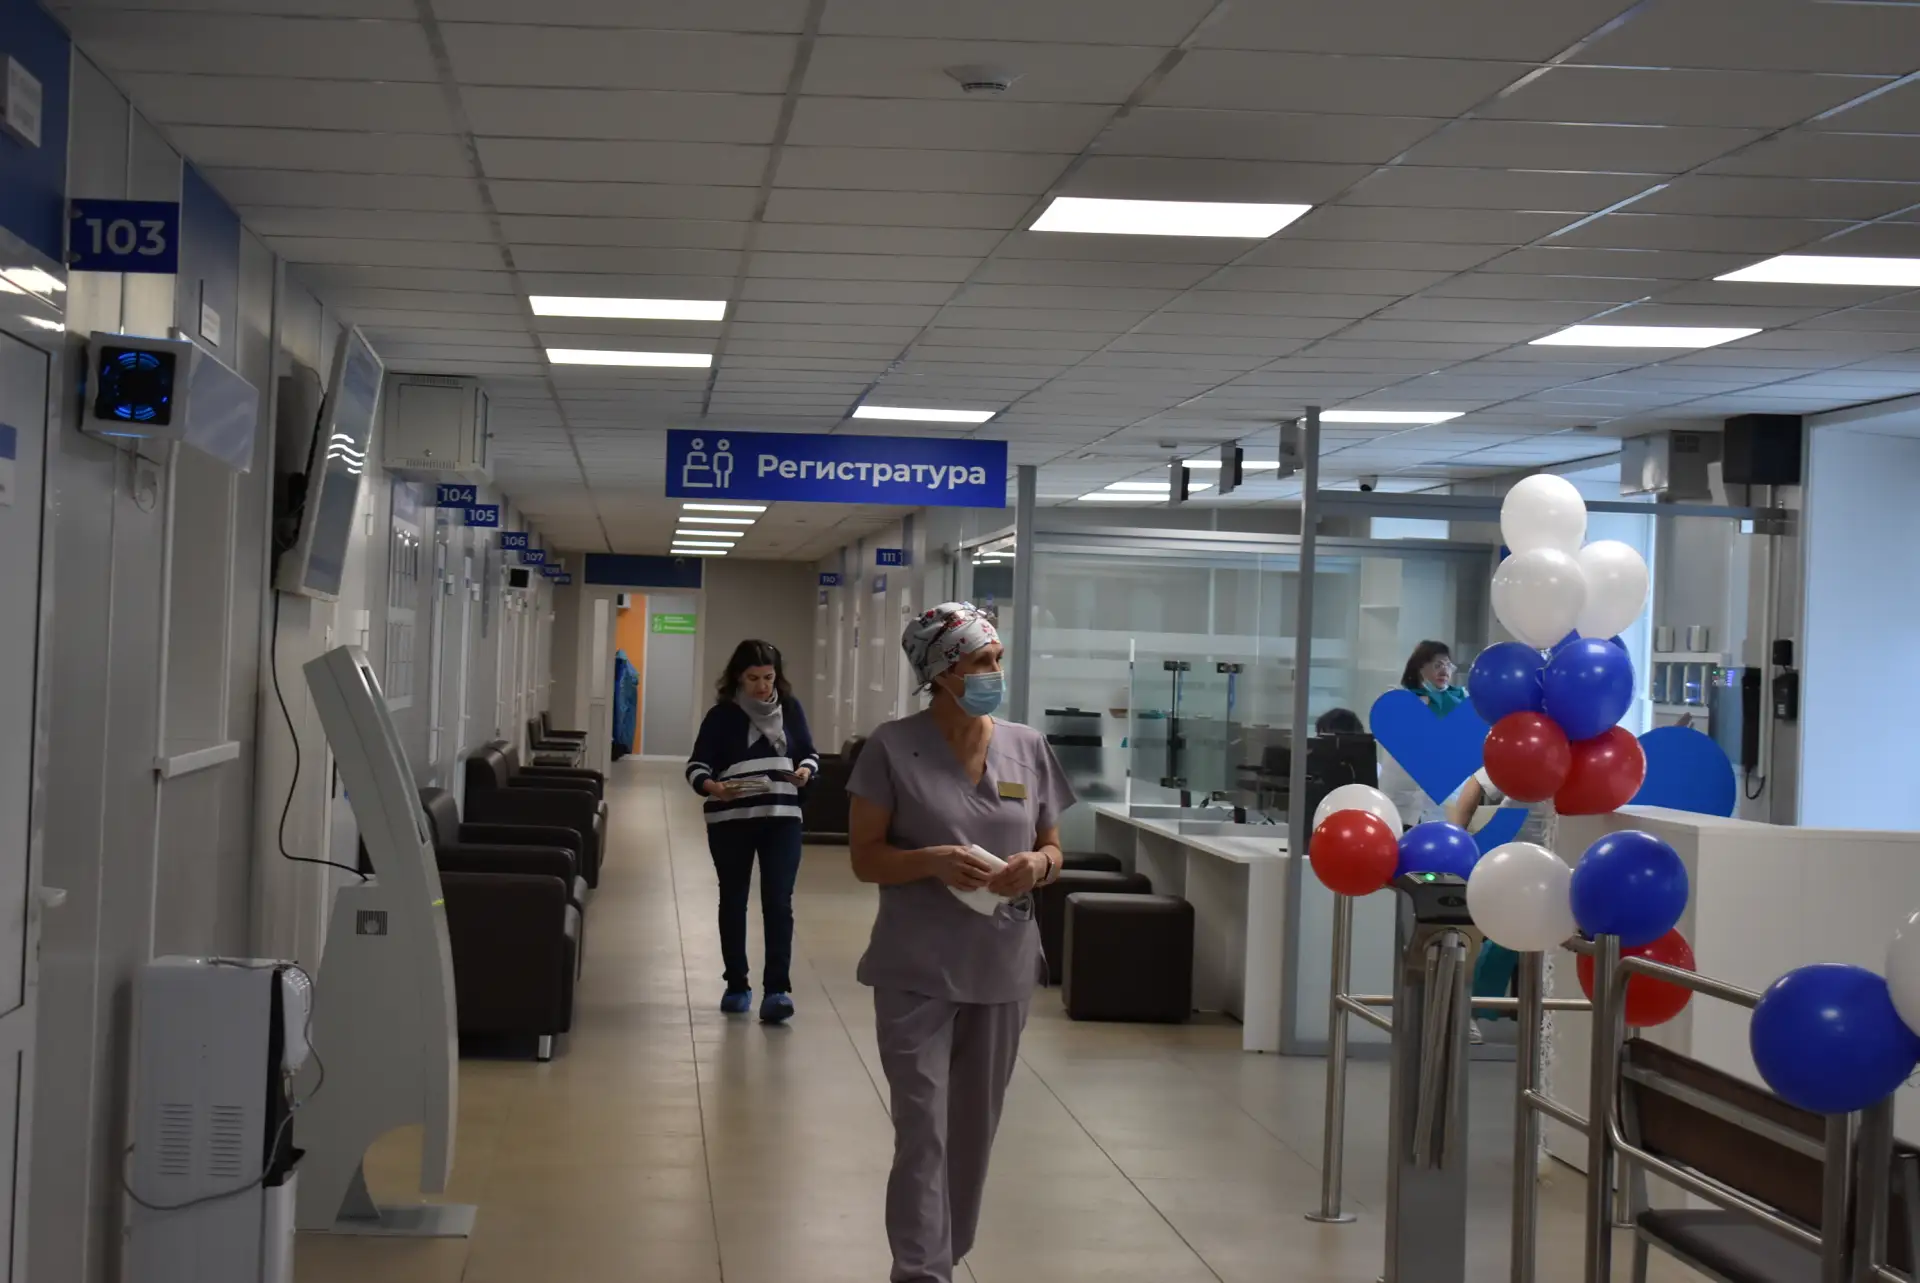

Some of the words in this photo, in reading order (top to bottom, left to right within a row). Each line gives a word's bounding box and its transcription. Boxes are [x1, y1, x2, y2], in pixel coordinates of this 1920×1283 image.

[86, 218, 166, 255] 103
[757, 454, 987, 490] Регистратура
[441, 488, 473, 502] 104
[469, 509, 496, 522] 105
[504, 536, 526, 546] 106
[525, 552, 544, 562] 107
[882, 552, 896, 562] 111
